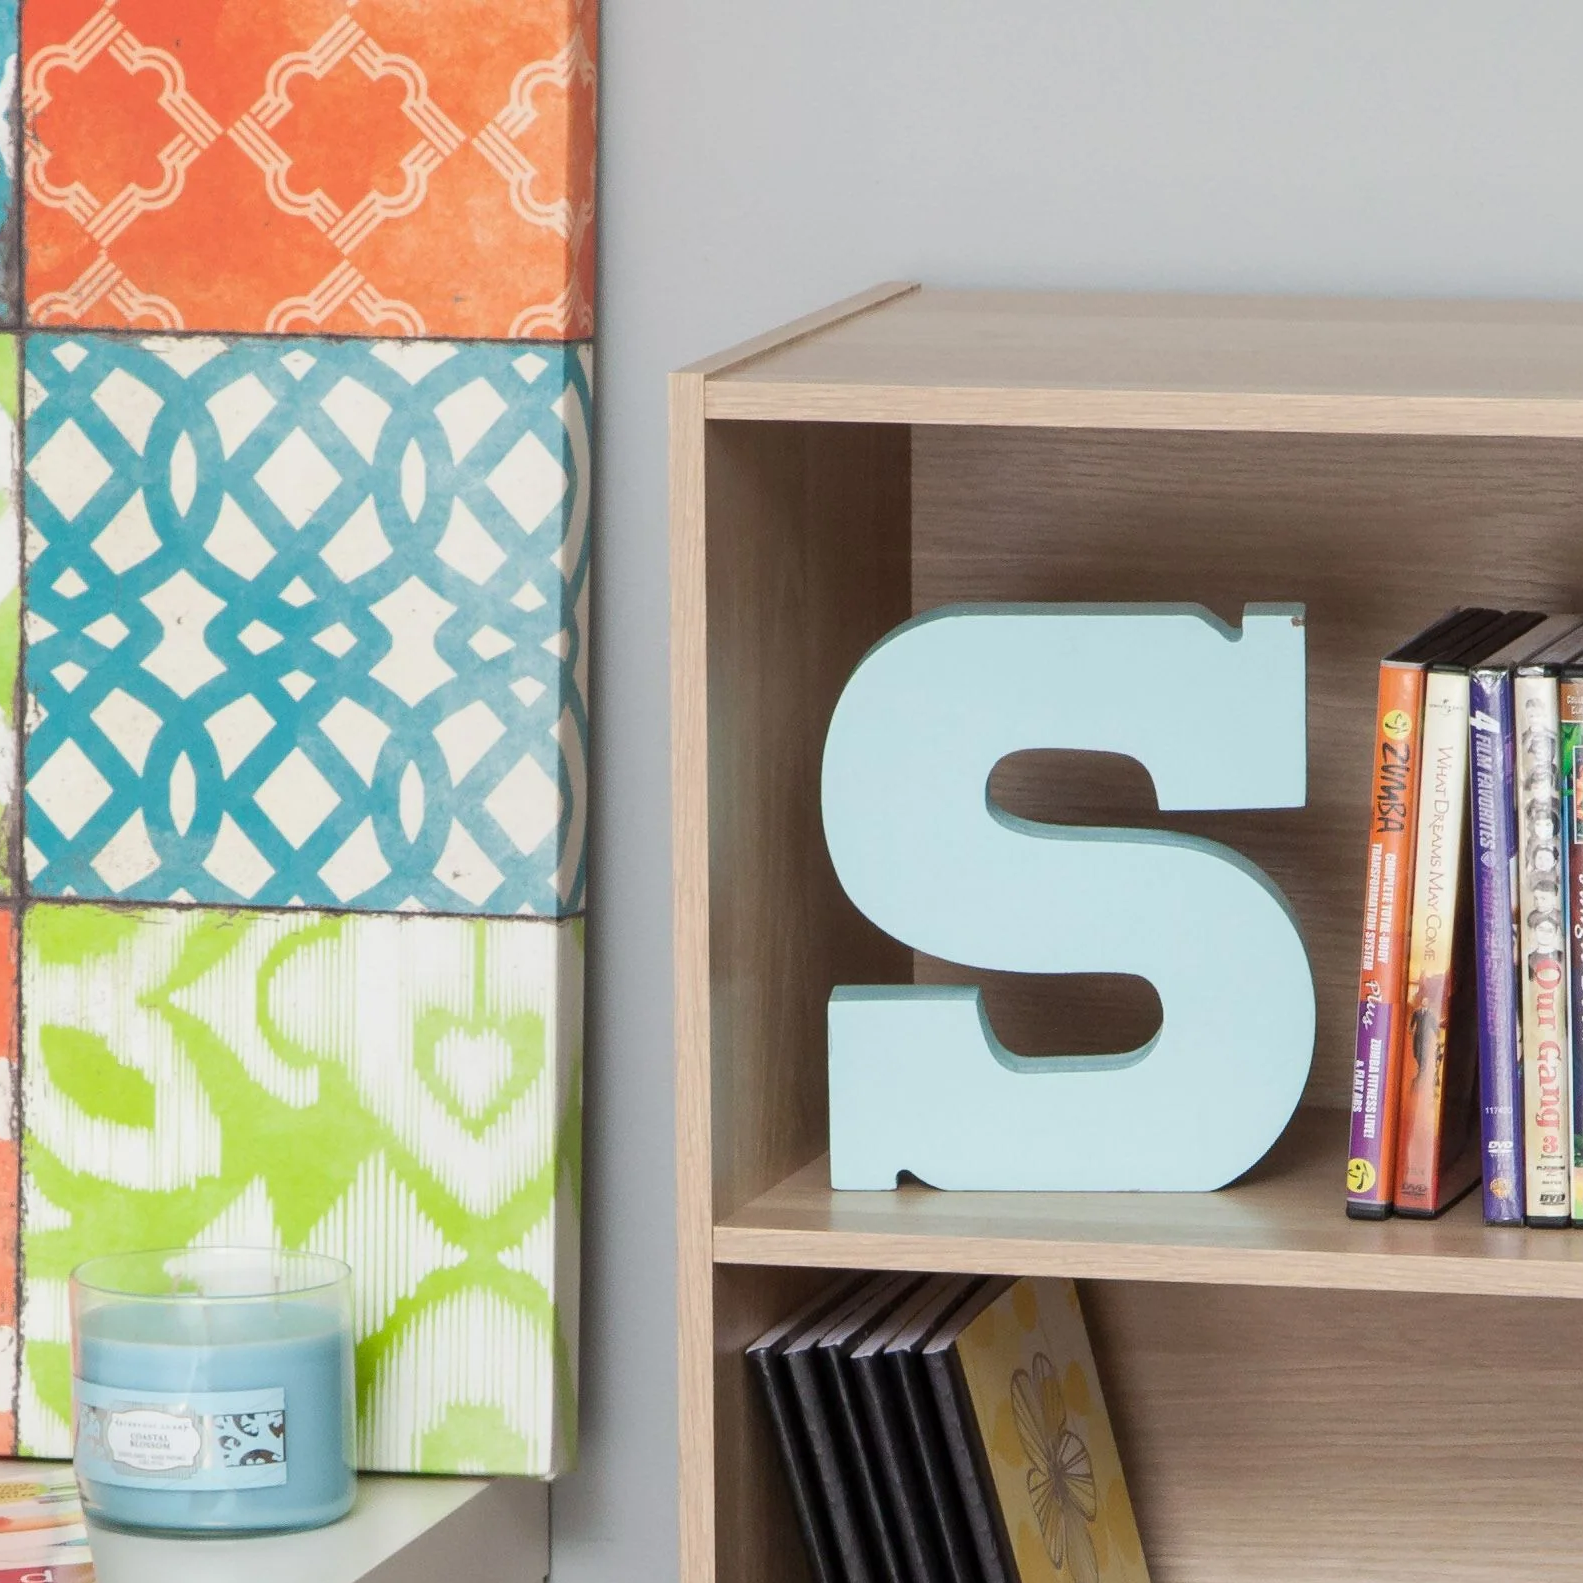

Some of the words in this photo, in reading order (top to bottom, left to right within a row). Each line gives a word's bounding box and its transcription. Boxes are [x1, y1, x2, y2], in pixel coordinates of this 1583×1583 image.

[1470, 710, 1500, 734] 4
[1434, 746, 1453, 799] WHAT
[1475, 733, 1492, 773] FILM
[1377, 742, 1410, 833] ZUMBA
[1477, 772, 1495, 850] FAVORITES
[1428, 800, 1450, 866] DREAMS
[821, 602, 1316, 1192] S
[1366, 843, 1383, 930] TRANSFORMATION
[1382, 853, 1397, 904] COMPLETE
[1426, 869, 1445, 912] MAY
[1363, 931, 1376, 971] SYSTEM
[1424, 914, 1442, 961] COME
[1362, 981, 1383, 1031] Plus
[1534, 960, 1561, 1030] Our
[1369, 1038, 1382, 1073] ZUMBA
[1365, 1073, 1379, 1113] FITNESS
[1535, 1041, 1561, 1129] Gang
[1488, 1140, 1513, 1150] DVD
[1539, 1193, 1566, 1202] DVD
